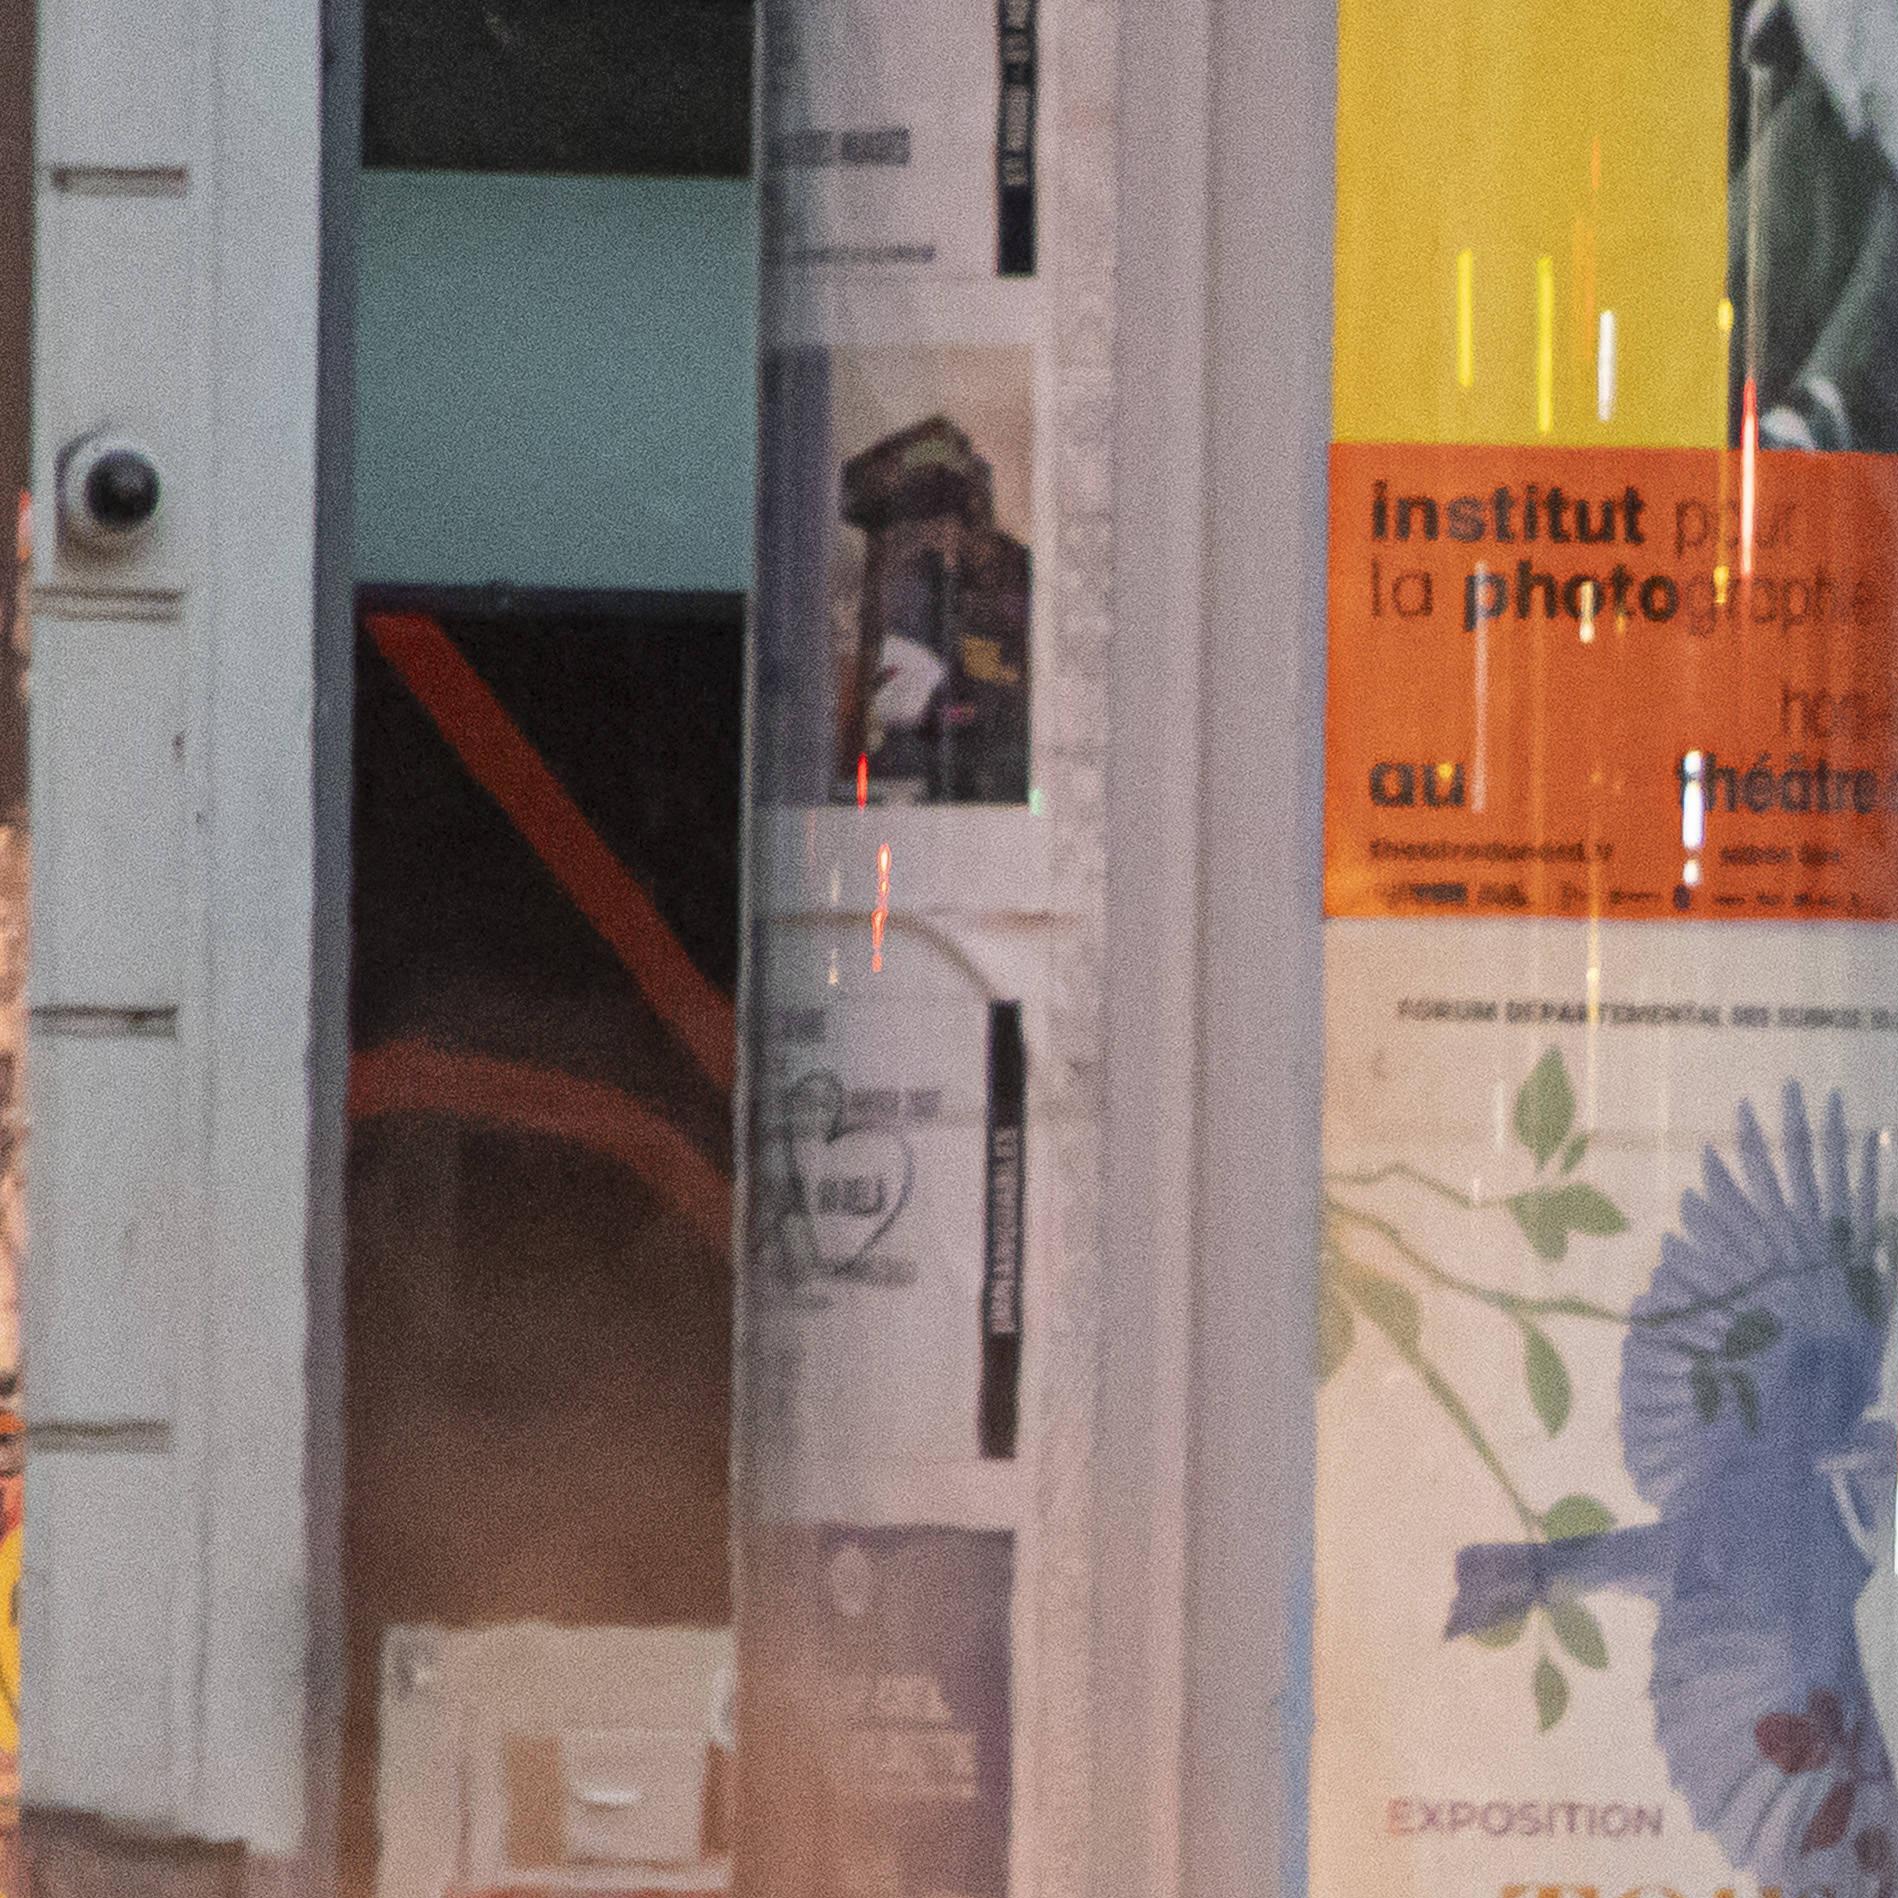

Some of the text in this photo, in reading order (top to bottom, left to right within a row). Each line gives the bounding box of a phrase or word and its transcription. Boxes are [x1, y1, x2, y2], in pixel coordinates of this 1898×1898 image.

[1371, 481, 1646, 545] institut
[1371, 560, 1434, 619] la
[1369, 760, 1465, 807] au
[1387, 1798, 1663, 1837] EXPOSITION
